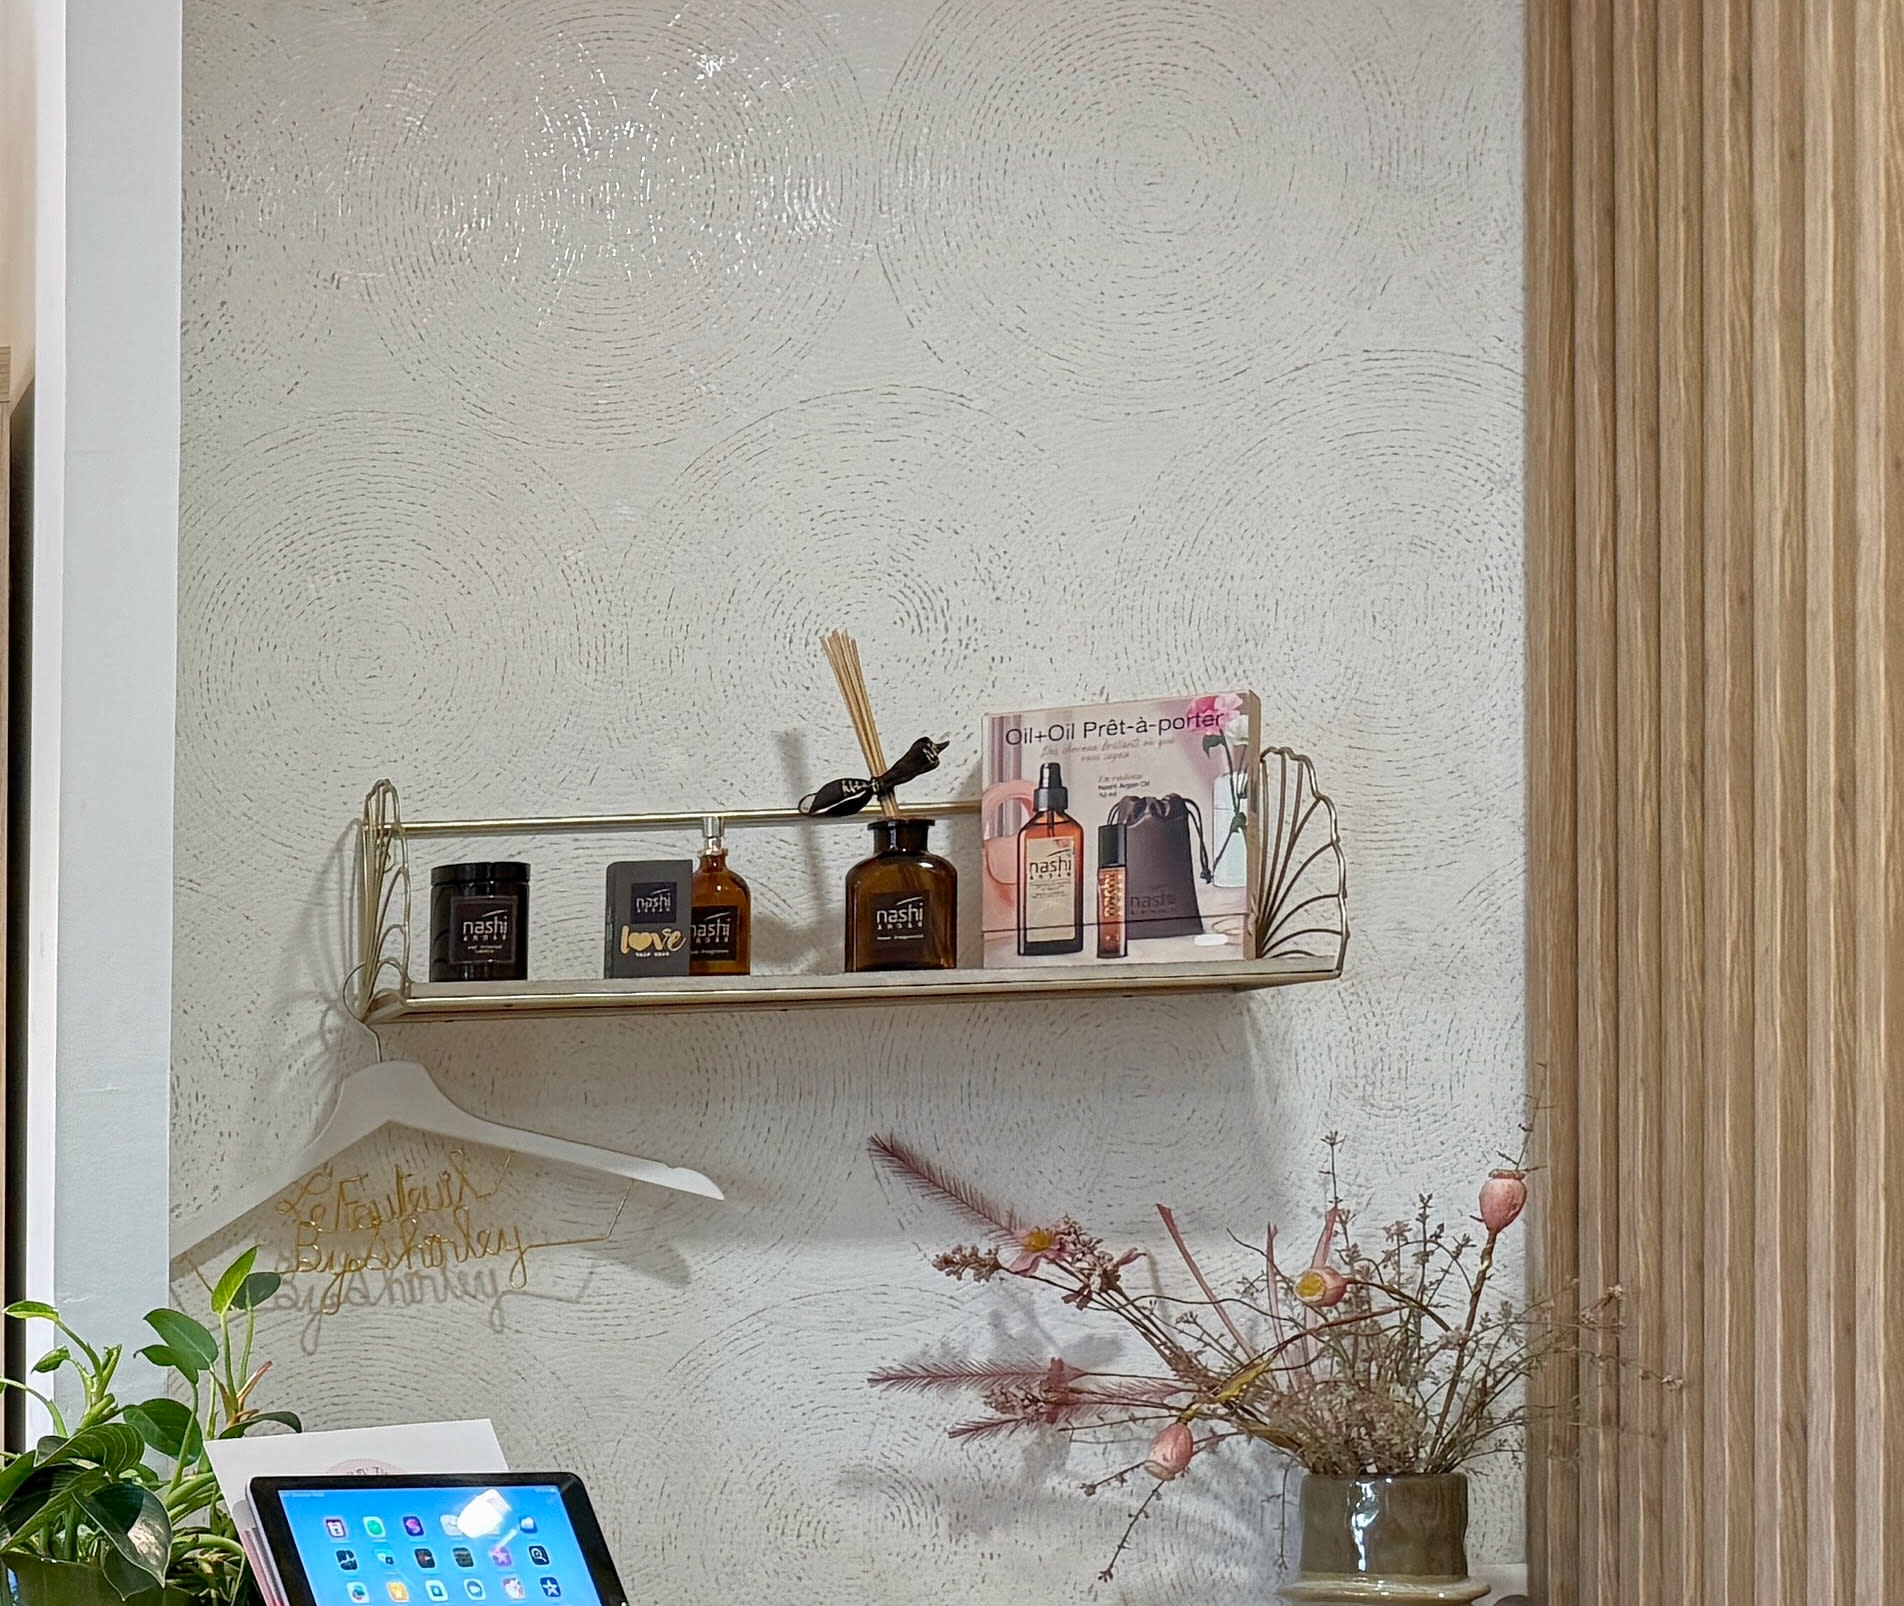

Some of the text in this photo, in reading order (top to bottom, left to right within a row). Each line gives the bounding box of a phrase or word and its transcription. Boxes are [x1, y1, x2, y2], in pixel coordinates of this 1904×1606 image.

[1005, 711, 1225, 746] Oil+Oil Prêt-à-porter
[1029, 856, 1072, 875] nashi
[462, 915, 508, 935] nashi
[876, 902, 924, 925] nashi
[620, 924, 687, 954] love
